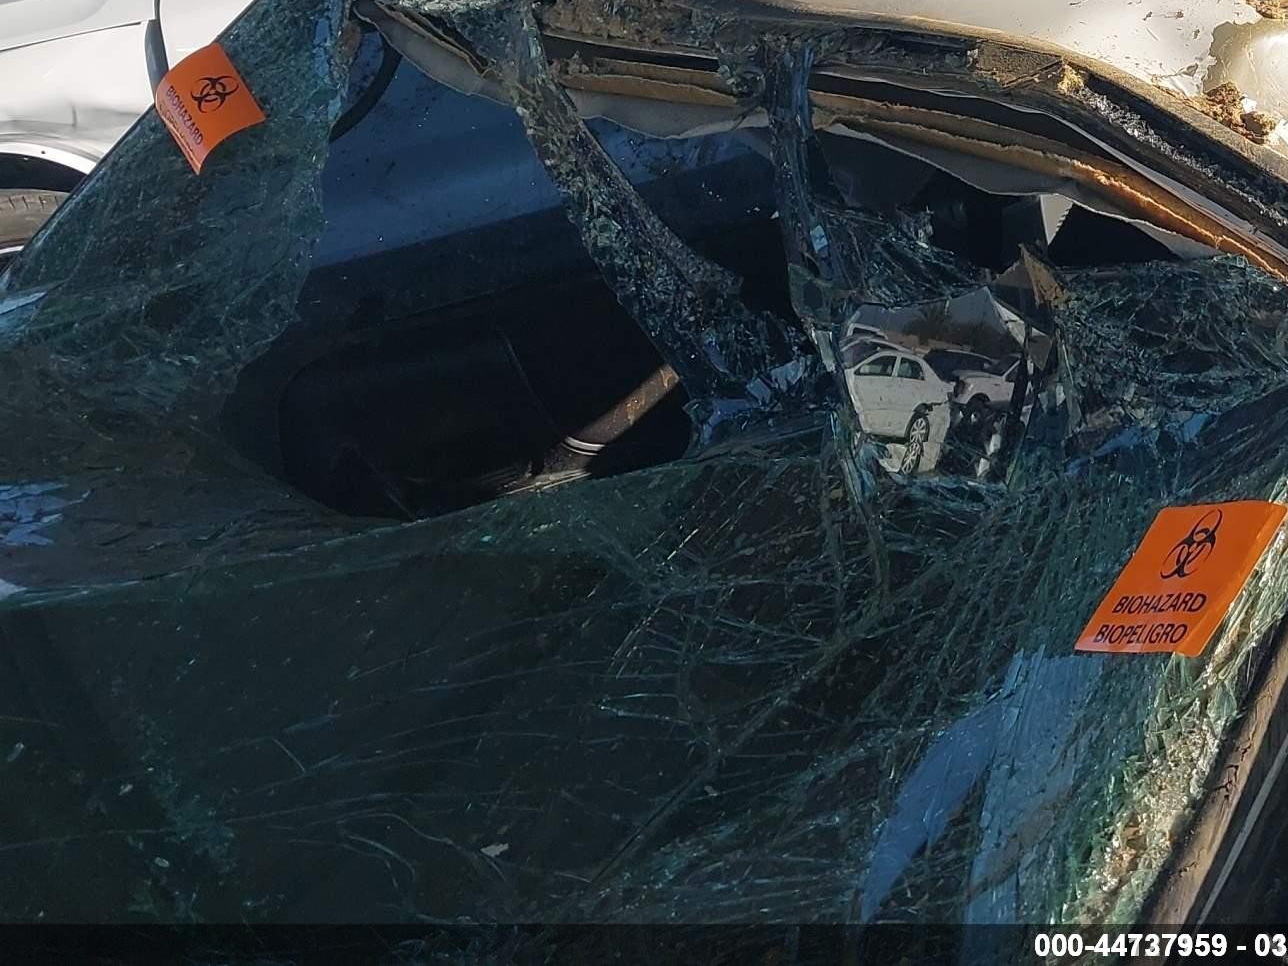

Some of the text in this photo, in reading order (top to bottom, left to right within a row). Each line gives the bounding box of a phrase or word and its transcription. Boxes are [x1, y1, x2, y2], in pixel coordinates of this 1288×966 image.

[165, 85, 204, 146] BIOHAZARD
[1112, 593, 1207, 615] BIOHAZARD
[1093, 623, 1188, 645] BIOPELIGRO
